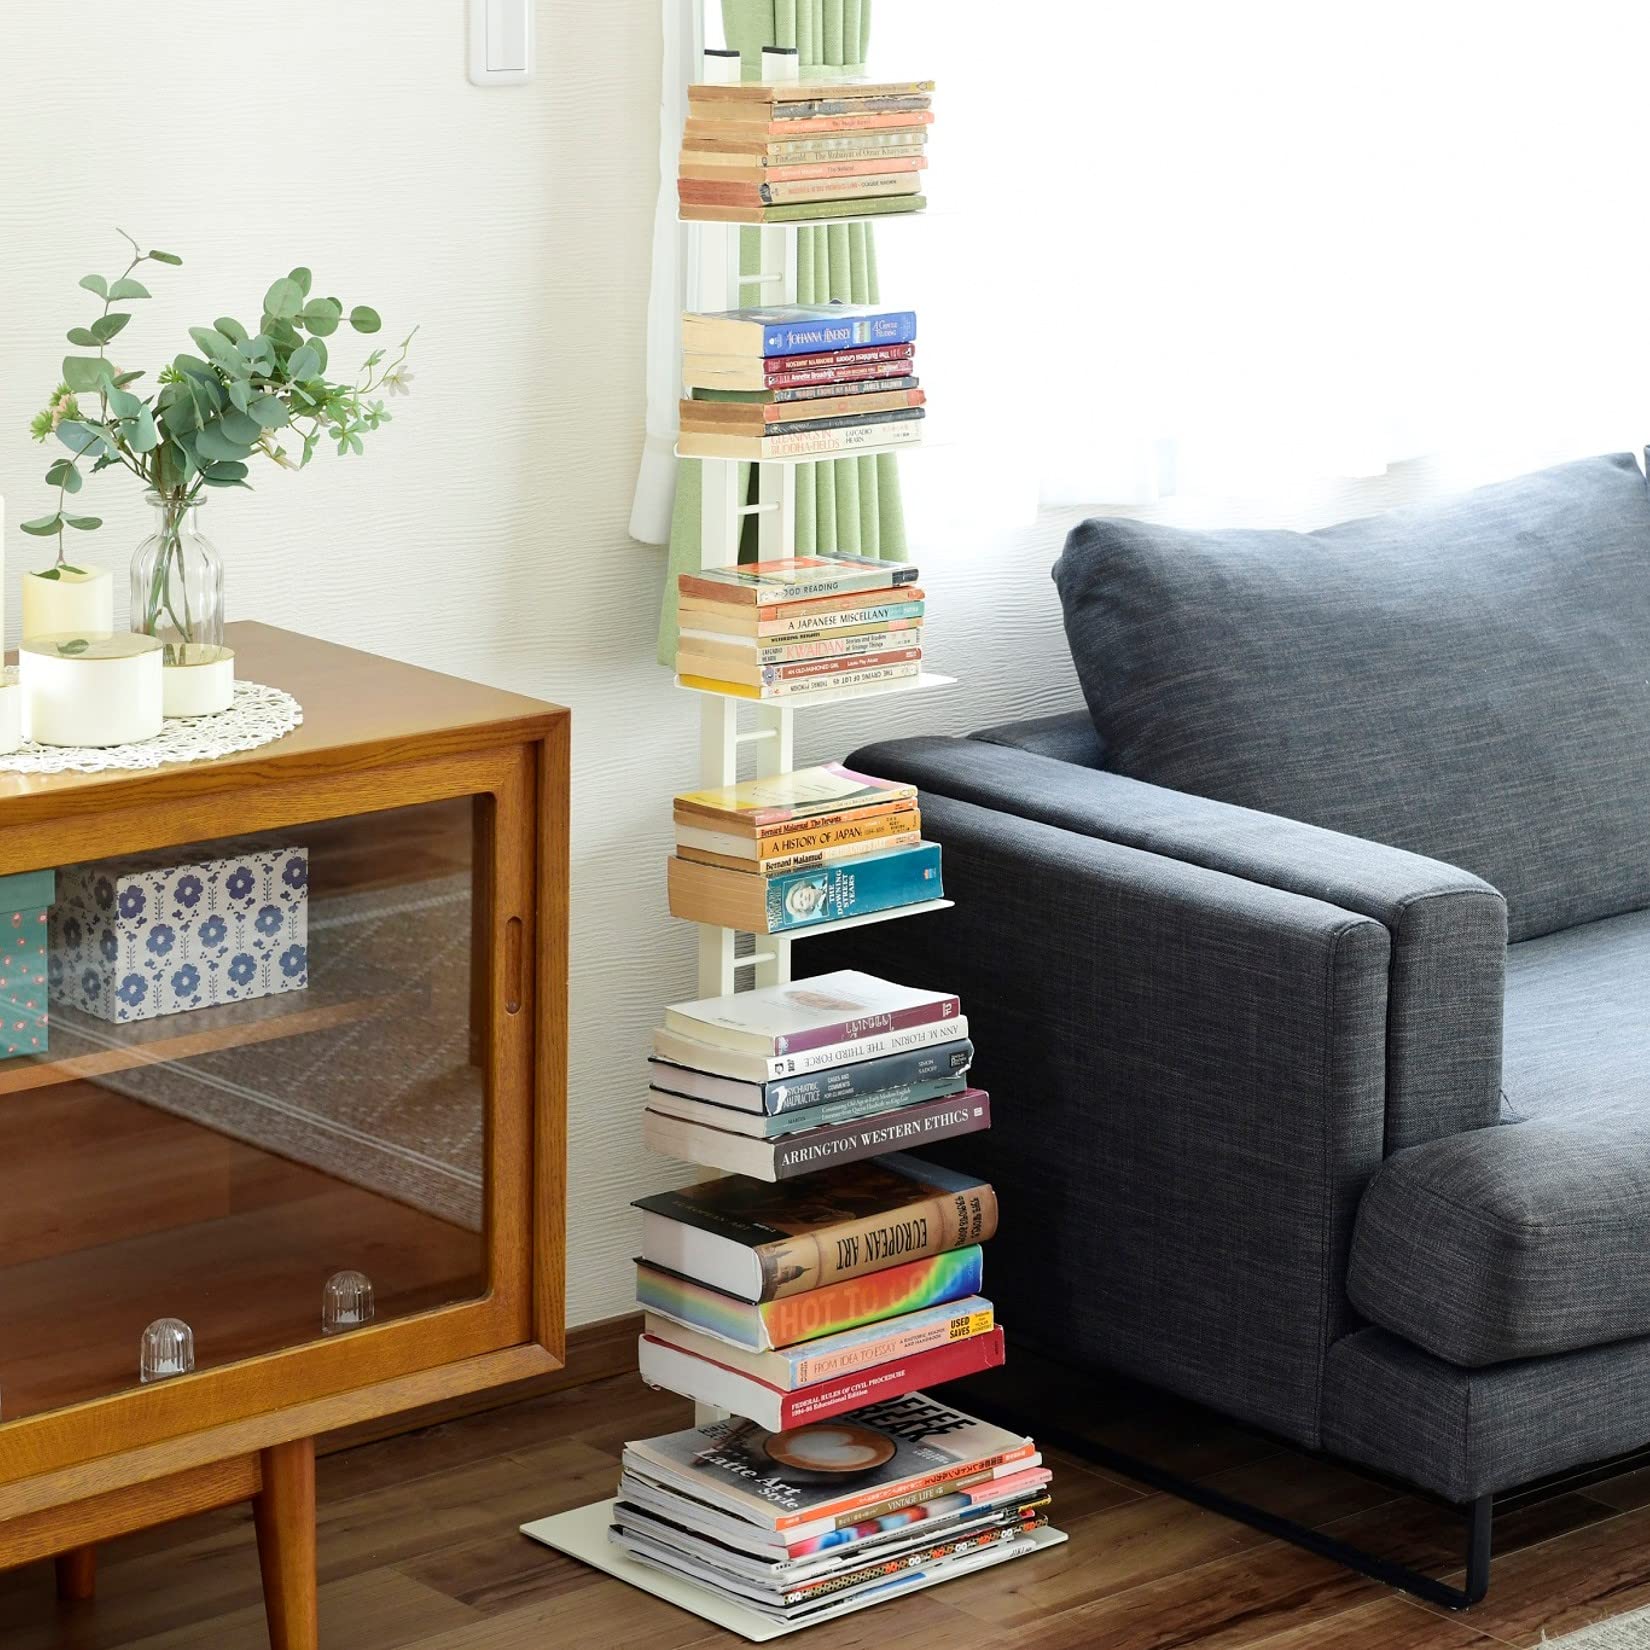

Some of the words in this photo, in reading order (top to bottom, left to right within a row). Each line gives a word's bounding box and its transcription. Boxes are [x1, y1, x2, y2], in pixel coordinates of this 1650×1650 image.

[803, 582, 839, 594] READING
[788, 621, 795, 630] A
[798, 615, 837, 629] JAPANESE
[839, 609, 889, 624] MISCELLANY
[786, 640, 844, 660] KWAIDAN
[841, 675, 852, 684] LOT
[861, 671, 882, 680] CRYING
[883, 669, 893, 677] THE
[772, 842, 780, 852] A
[781, 834, 816, 849] HISTORY
[819, 832, 831, 844] OF
[765, 857, 792, 870] Bernard
[792, 852, 823, 865] Malamud
[836, 869, 844, 915] DOWNING
[891, 1031, 926, 1047] FLORINI
[940, 1024, 959, 1037] ANN
[834, 1045, 865, 1060] THIRD
[866, 1041, 885, 1052] THE
[803, 1051, 833, 1067] FORCE
[781, 1137, 858, 1166] ARRINGTON
[861, 1119, 922, 1146] WESTERN
[924, 1108, 969, 1131] ETHICS
[864, 1218, 928, 1263] EUROPEAN
[836, 1235, 859, 1270] ART
[778, 1297, 835, 1340] HOT
[842, 1280, 880, 1320] TO
[950, 1316, 970, 1329] USED
[950, 1326, 970, 1339] SAVES
[814, 1360, 838, 1374] FROM
[839, 1354, 859, 1370] IDEA
[860, 1348, 873, 1365] TO
[873, 1341, 897, 1360] ESSAY
[791, 1395, 820, 1411] FEDERAL
[821, 1389, 841, 1402] RULES
[842, 1386, 850, 1394] OF
[850, 1381, 867, 1393] CIVIL
[868, 1369, 906, 1388] PROCEDURE
[814, 1394, 847, 1411] Educational
[847, 1389, 868, 1400] Edition
[692, 1448, 758, 1479] Latte
[755, 1476, 802, 1497] Art
[757, 1487, 799, 1509] Style
[887, 1495, 917, 1511] VINTAGE
[919, 1488, 934, 1501] LIFE
